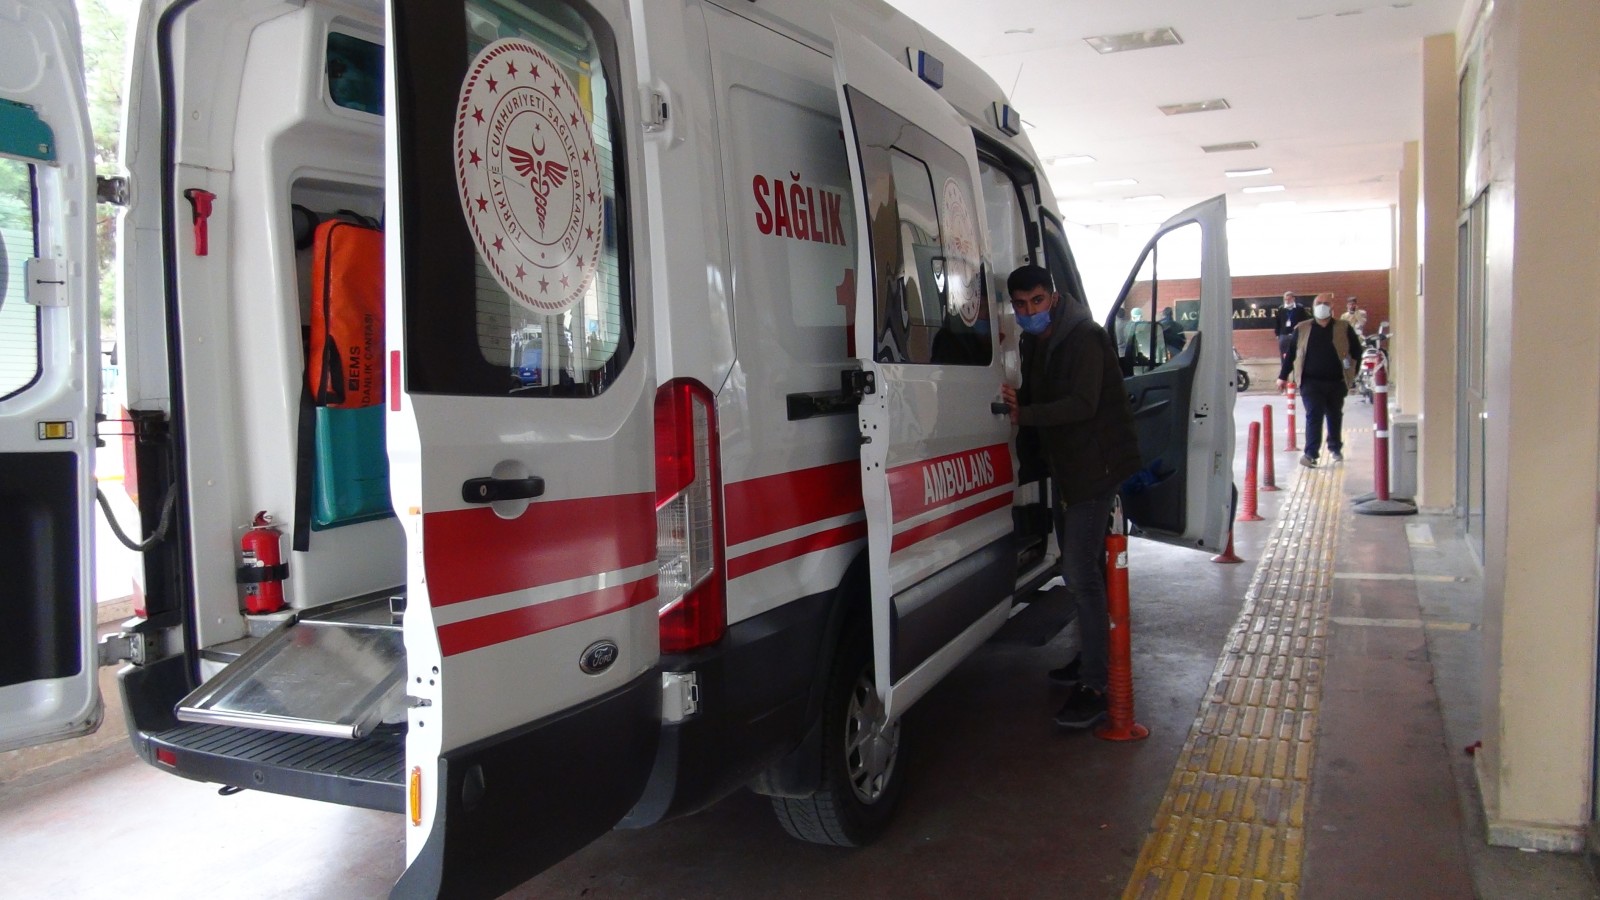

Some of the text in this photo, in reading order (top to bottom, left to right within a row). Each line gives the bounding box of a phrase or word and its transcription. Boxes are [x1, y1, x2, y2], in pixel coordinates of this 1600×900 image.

[491, 92, 582, 253] TÜRKİYE CUMHURİYETİ SAĞLIK BAKANLIĞI
[752, 170, 847, 247] SAĞLIK
[1180, 309, 1200, 321] AC
[349, 345, 360, 378] EMS
[922, 450, 995, 506] AMBULANS
